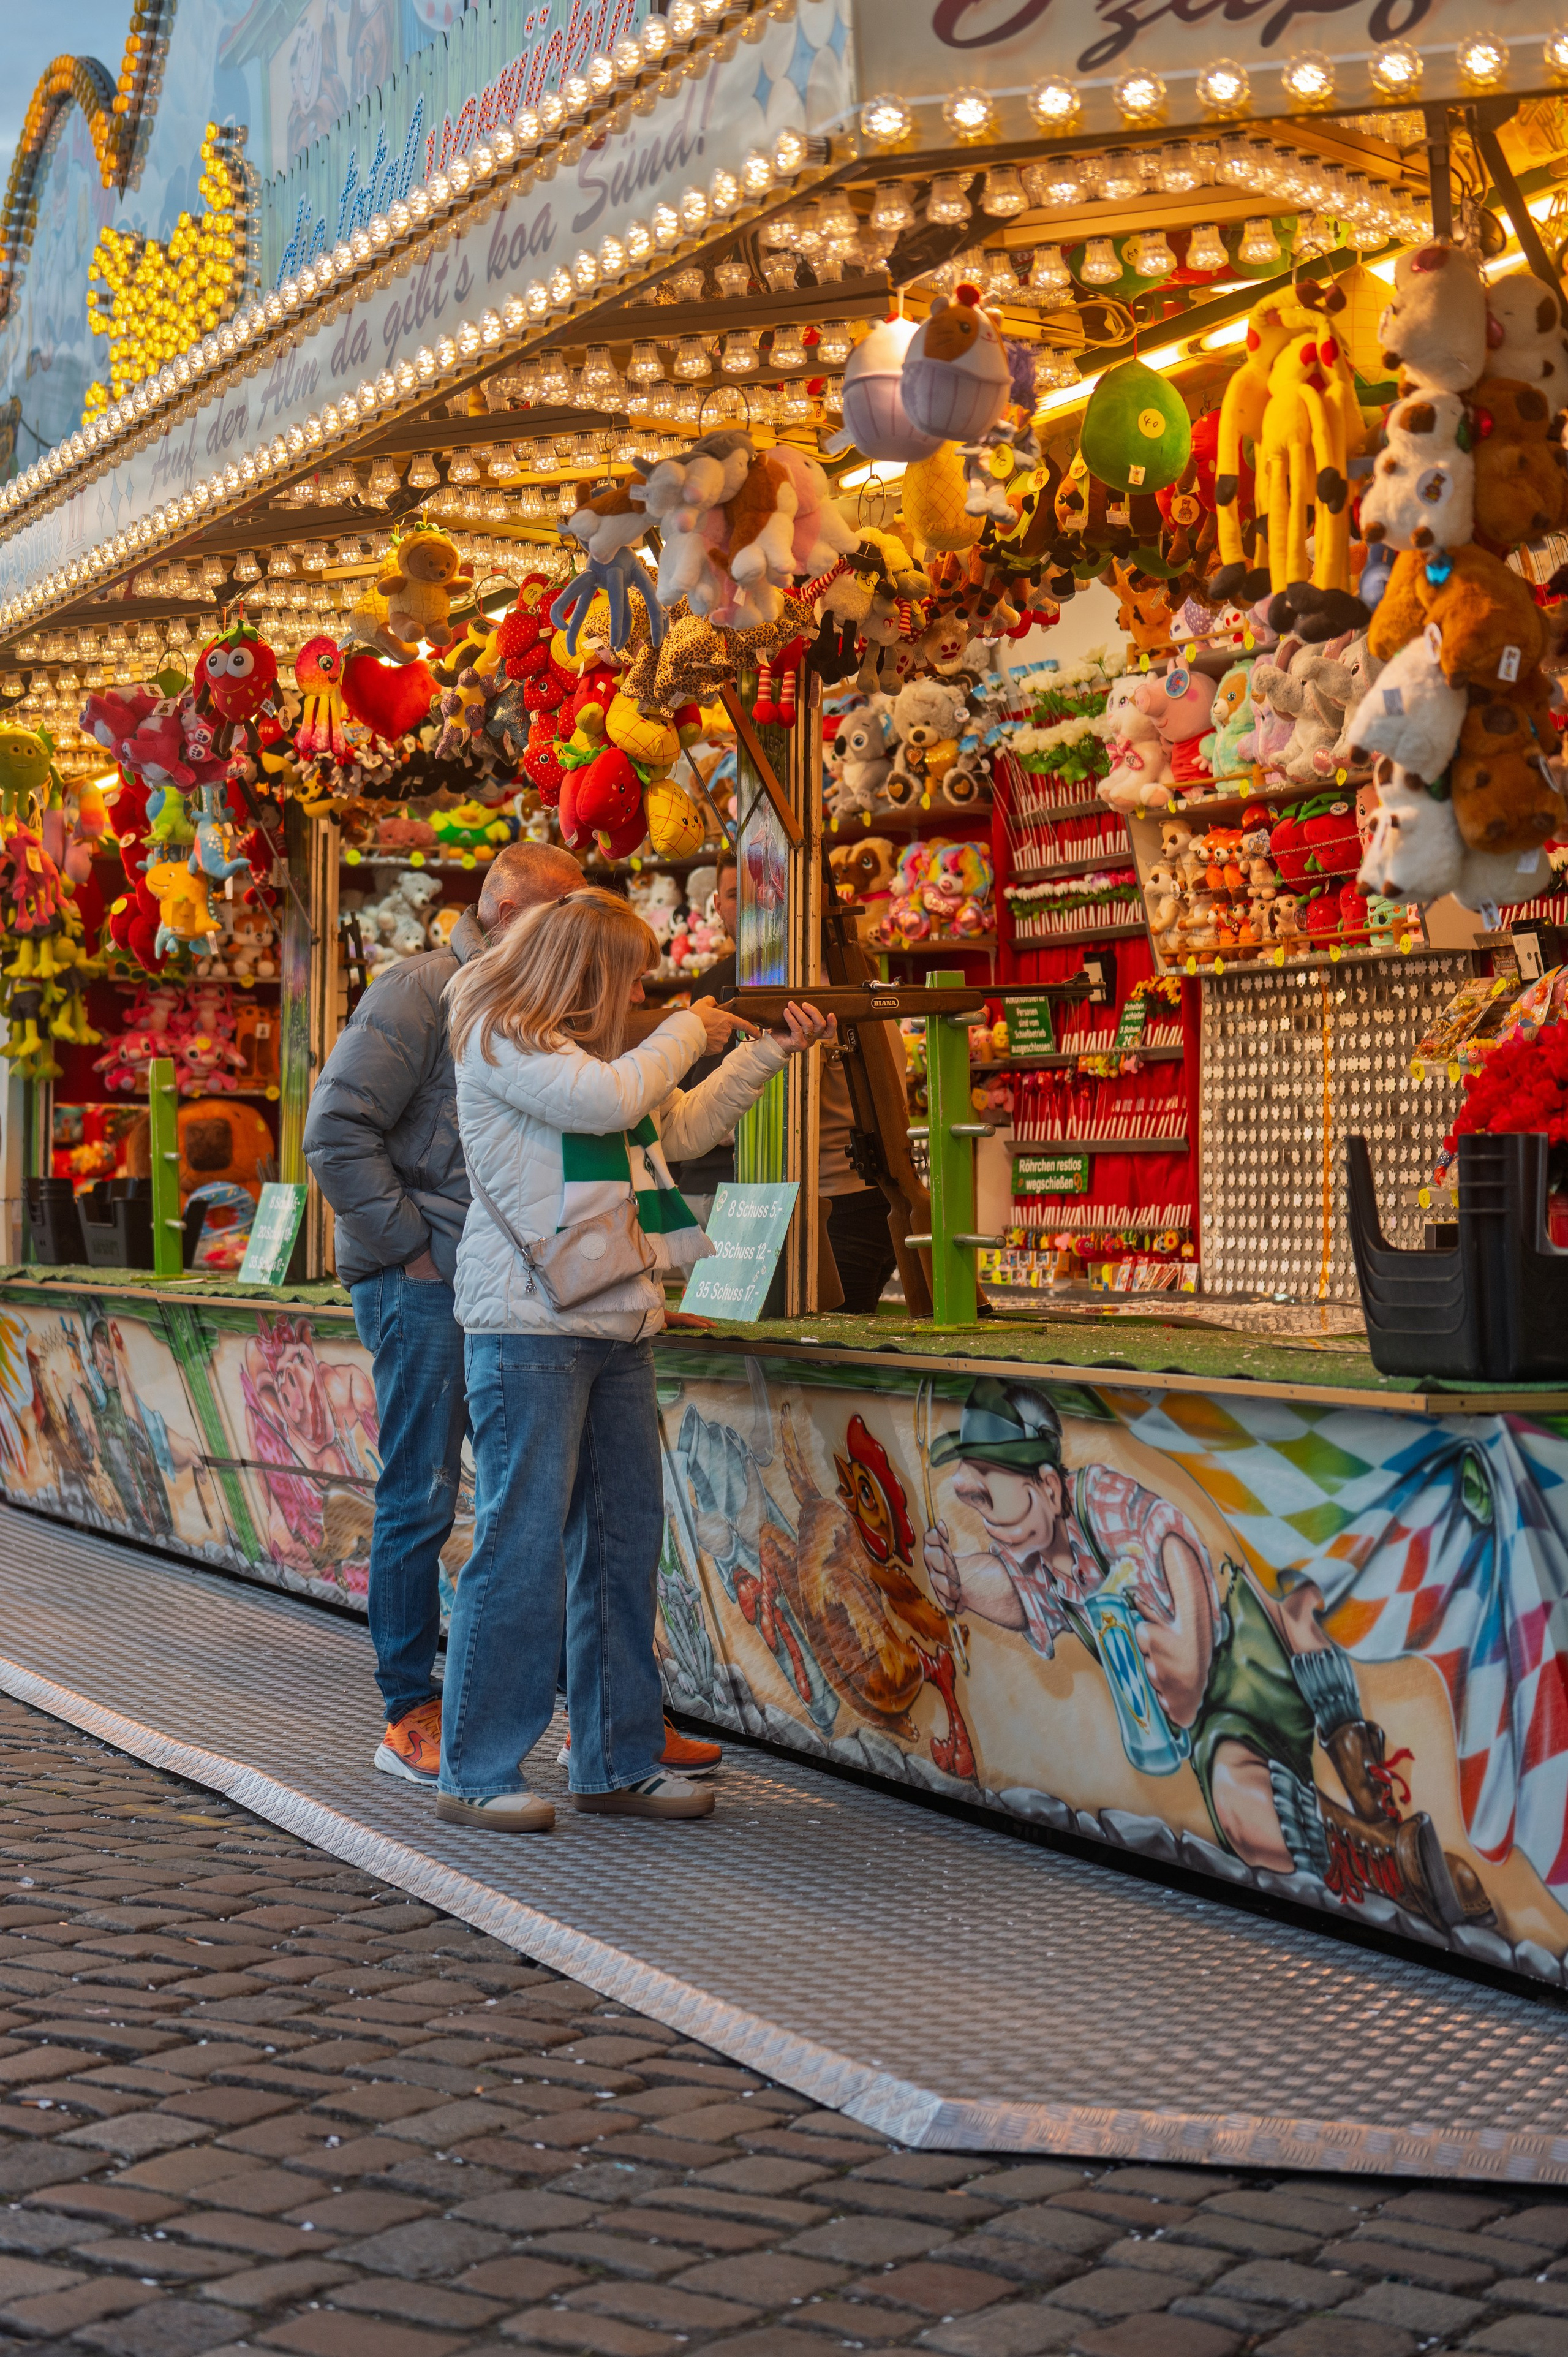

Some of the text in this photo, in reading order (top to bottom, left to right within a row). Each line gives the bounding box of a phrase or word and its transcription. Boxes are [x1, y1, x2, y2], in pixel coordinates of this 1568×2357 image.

[149, 412, 198, 500] Auf
[206, 394, 249, 456] der
[258, 342, 320, 431] Alm
[331, 308, 373, 378] da
[487, 200, 557, 284] koa
[571, 61, 719, 233] Sünd!
[1144, 415, 1159, 428] 40
[861, 572, 876, 587] 35
[527, 588, 538, 599] 18
[1016, 1008, 1038, 1017] Personen
[1019, 1018, 1039, 1028] sind vom
[848, 1029, 857, 1047] ANA
[1014, 1028, 1046, 1040] Schießbetrieb
[1019, 1156, 1082, 1173] Röhrchen restlos
[1025, 1175, 1074, 1194] wegschießen
[269, 1195, 276, 1209] 8
[728, 1200, 783, 1220] 8 Schuss 5,-
[257, 1225, 266, 1239] 20
[722, 1241, 755, 1260] Schuss
[755, 1243, 772, 1262] 12,-
[248, 1255, 258, 1269] 35
[696, 1281, 760, 1304] 35 Schuss 17,-
